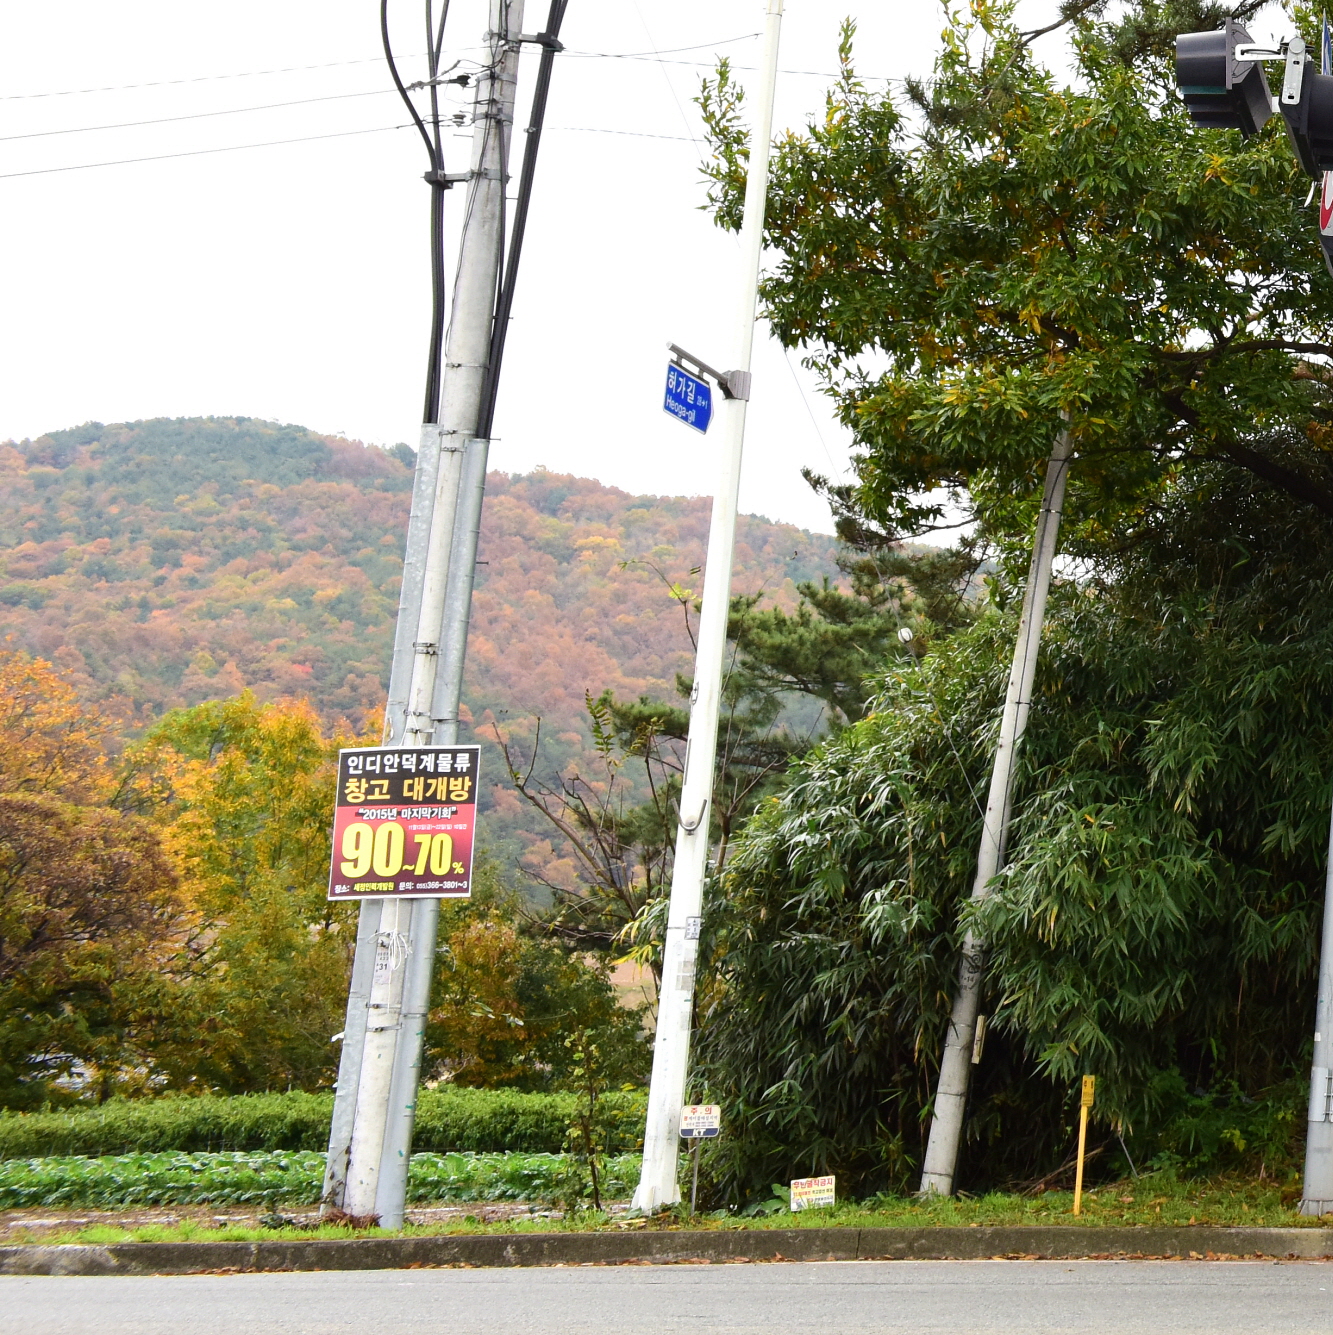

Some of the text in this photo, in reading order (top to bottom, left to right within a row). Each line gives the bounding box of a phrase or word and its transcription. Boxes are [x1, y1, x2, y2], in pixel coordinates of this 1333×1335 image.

[668, 371, 696, 405] 허가길
[666, 394, 696, 423] Heoga-gil
[347, 753, 471, 775] 인디안덕계물류
[344, 776, 472, 803] 창고 대개방
[692, 1129, 706, 1137] KT
